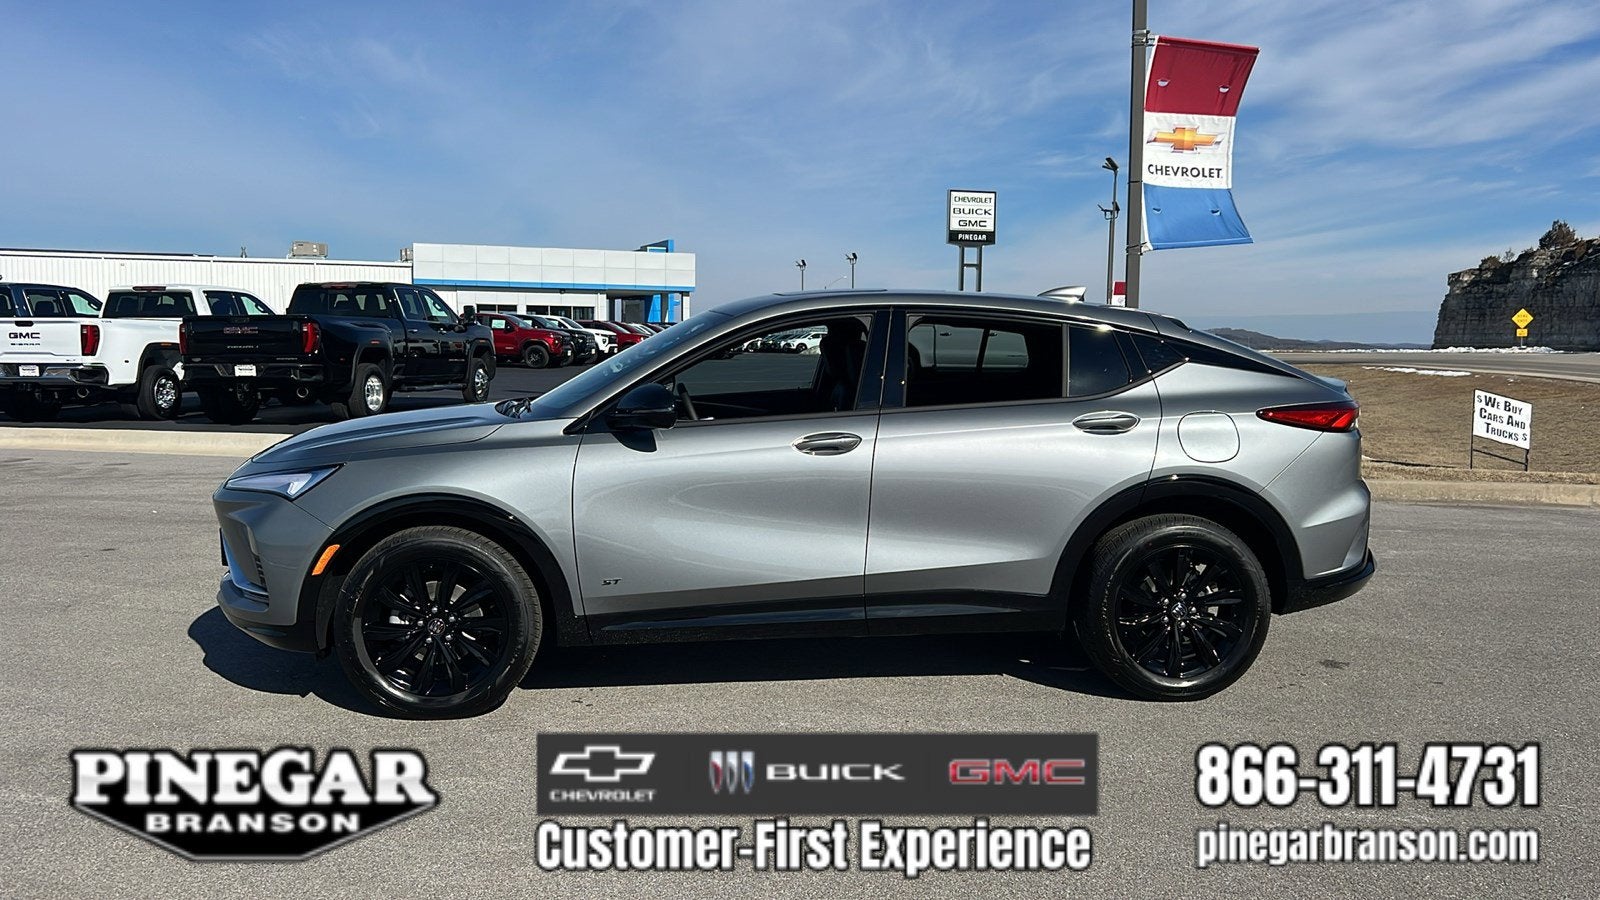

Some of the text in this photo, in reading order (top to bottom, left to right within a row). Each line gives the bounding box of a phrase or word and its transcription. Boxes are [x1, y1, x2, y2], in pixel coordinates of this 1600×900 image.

[1147, 164, 1223, 179] CHEVROLET
[954, 196, 992, 204] CHEVROLET
[953, 207, 992, 216] BUICK
[958, 219, 987, 227] GMC
[958, 233, 987, 241] PINEGAR
